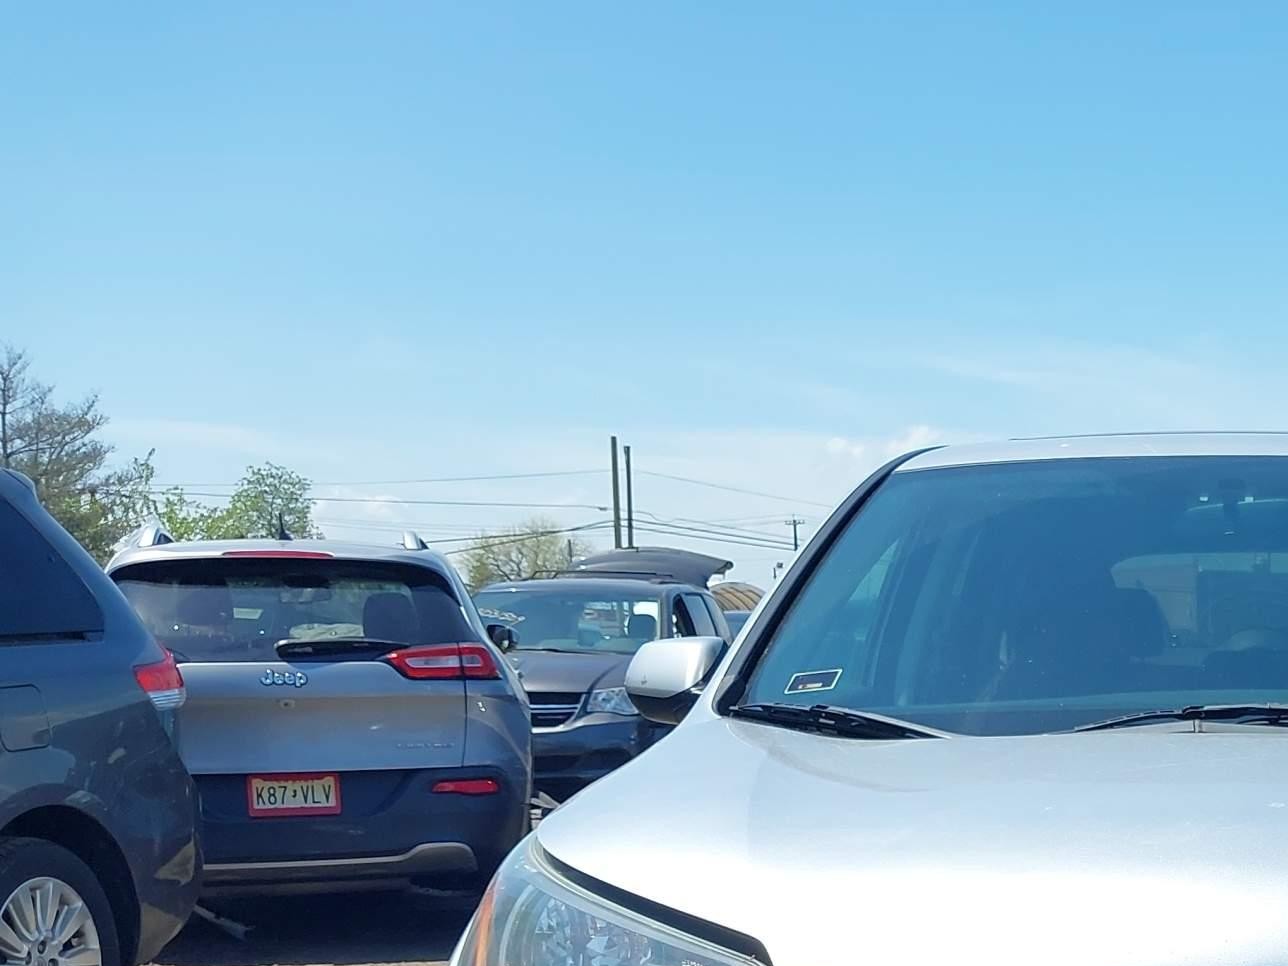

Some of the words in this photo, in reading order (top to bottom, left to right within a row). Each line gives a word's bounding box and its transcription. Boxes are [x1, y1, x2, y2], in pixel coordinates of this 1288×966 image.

[260, 669, 308, 687] Jeep
[256, 786, 287, 805] K87
[301, 784, 331, 804] VLV
